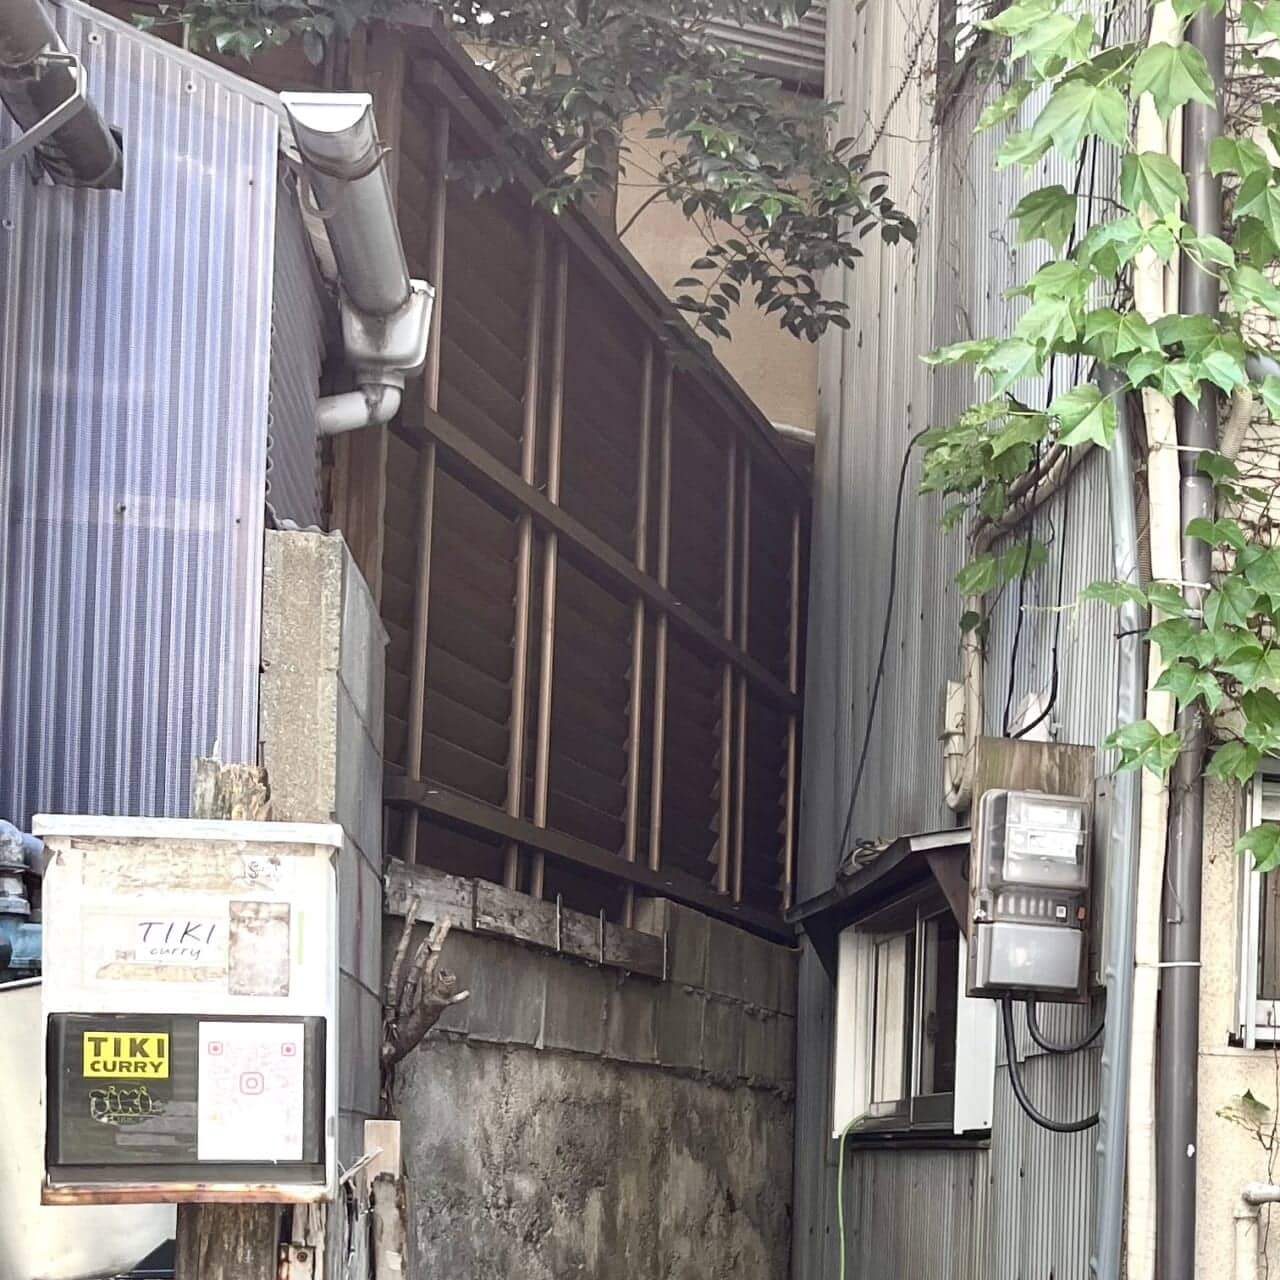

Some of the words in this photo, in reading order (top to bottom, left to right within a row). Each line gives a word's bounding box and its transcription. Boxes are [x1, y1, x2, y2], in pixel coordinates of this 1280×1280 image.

[138, 921, 216, 945] TIKI
[150, 947, 201, 961] curry
[88, 1037, 165, 1058] TIKI
[90, 1060, 163, 1073] CURRY
